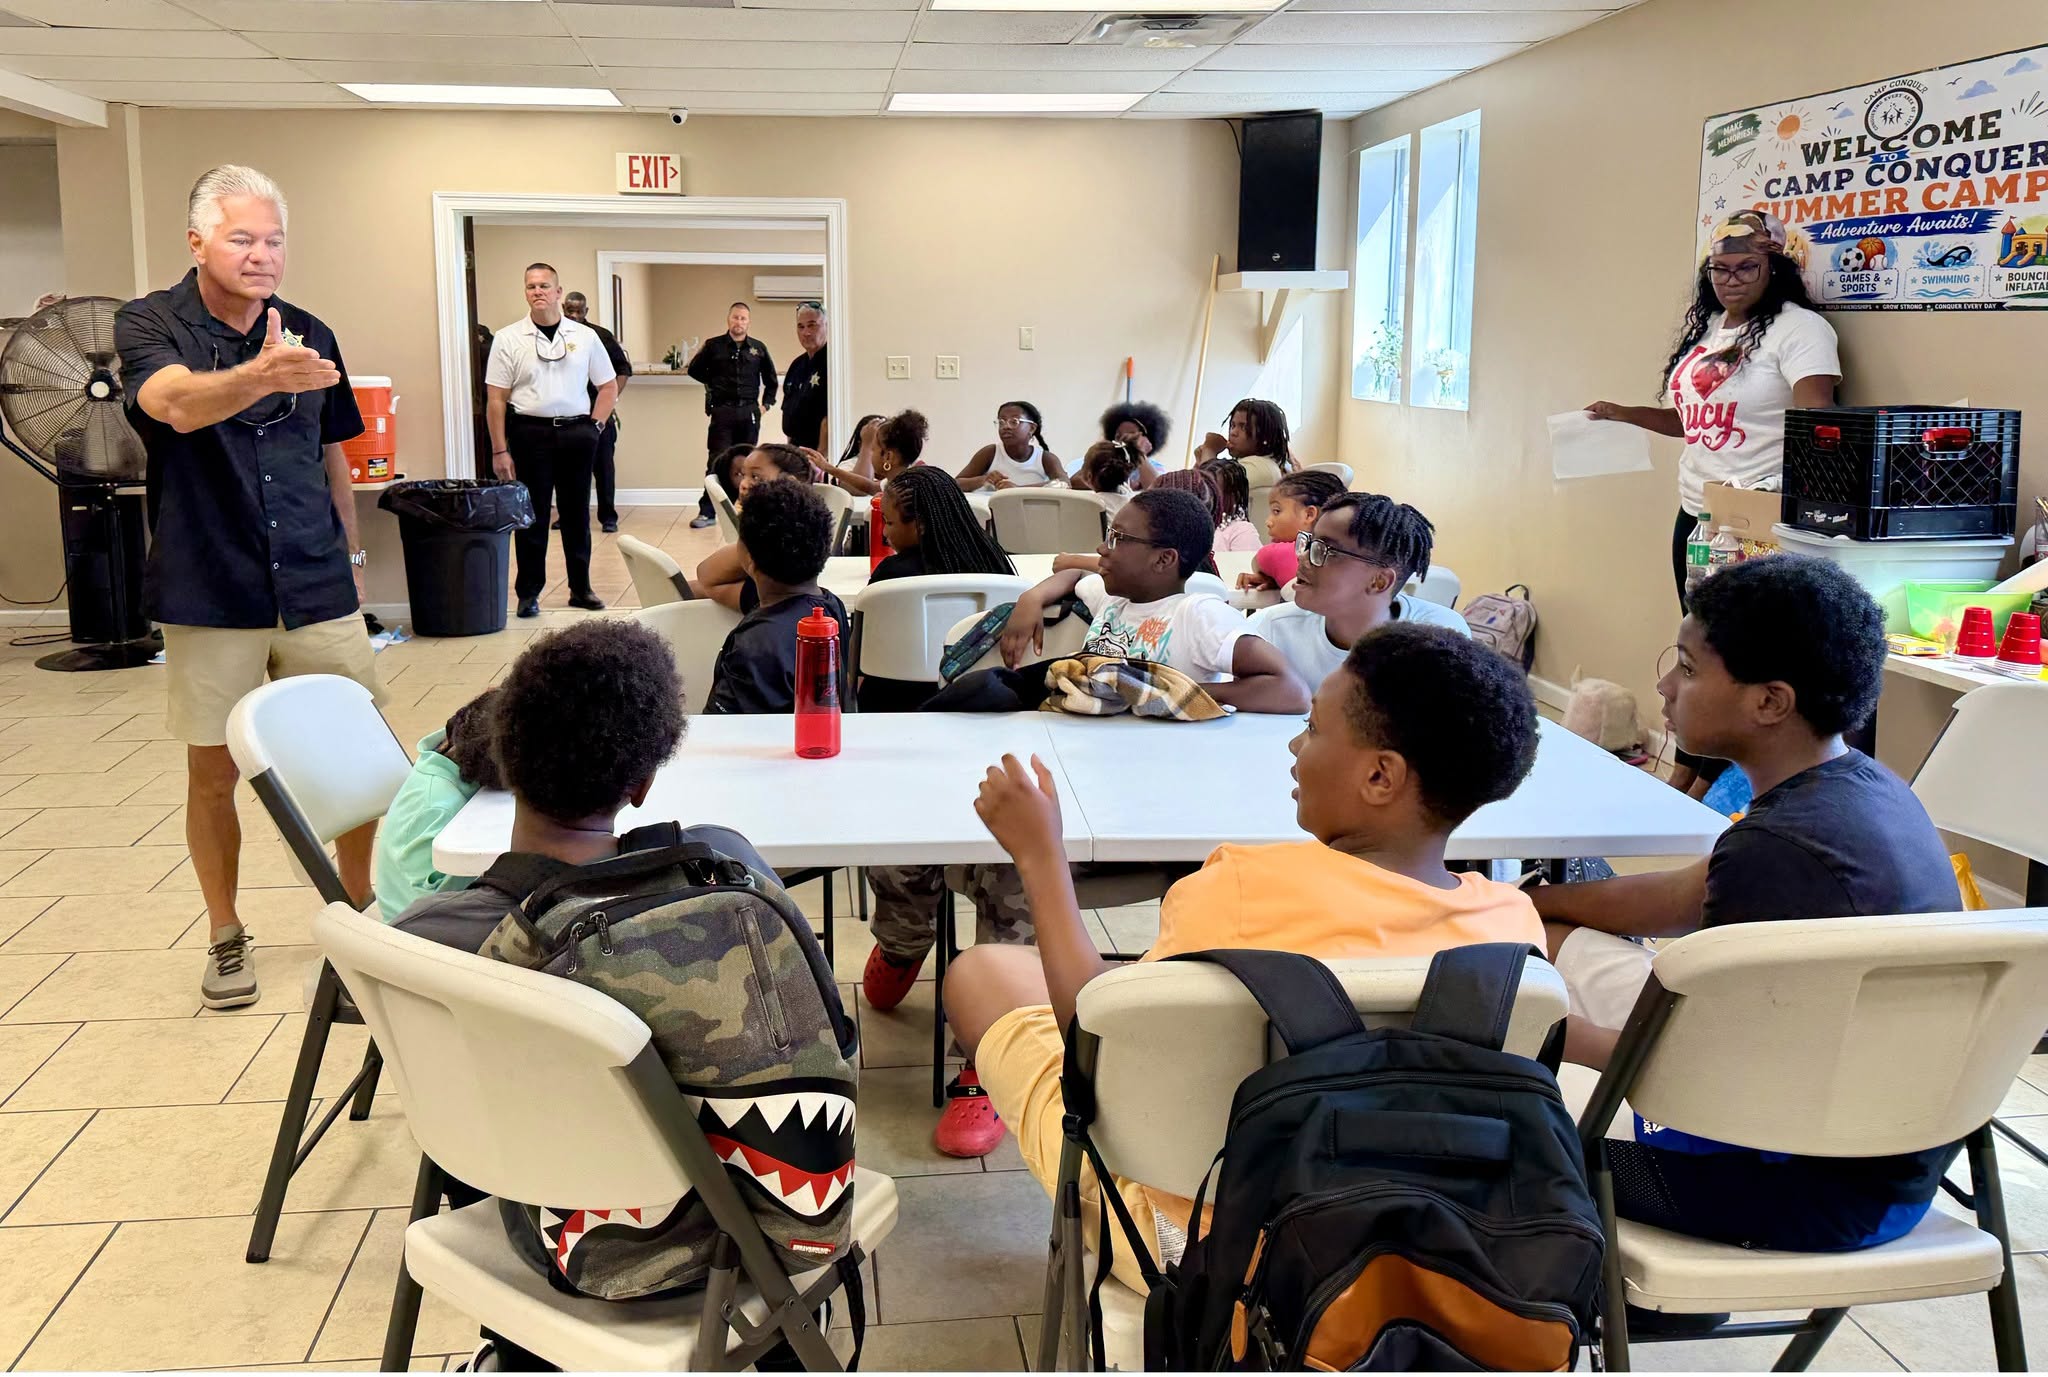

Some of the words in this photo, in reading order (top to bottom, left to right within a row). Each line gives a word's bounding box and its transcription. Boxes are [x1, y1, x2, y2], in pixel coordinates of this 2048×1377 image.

[1864, 85, 1887, 105] CAMP
[1889, 79, 1928, 94] CONQUER
[1717, 126, 1754, 149] MEMORIES!
[1723, 120, 1744, 135] MAKE
[1800, 109, 2002, 167] WELCOME
[1880, 152, 1899, 162] TO
[628, 155, 671, 188] EXIT
[1764, 168, 1854, 199] CAMP
[1865, 140, 2048, 187] CONQUER
[1922, 169, 2048, 211] CAMP
[1820, 220, 1903, 239] Adventure
[1906, 211, 1978, 233] Awaits!
[1840, 273, 1871, 283] GAMES
[1873, 273, 1880, 281] &
[1841, 283, 1877, 292] SPORTS
[1922, 274, 1970, 285] SWIMMING
[2008, 271, 2048, 281] BOUNCI
